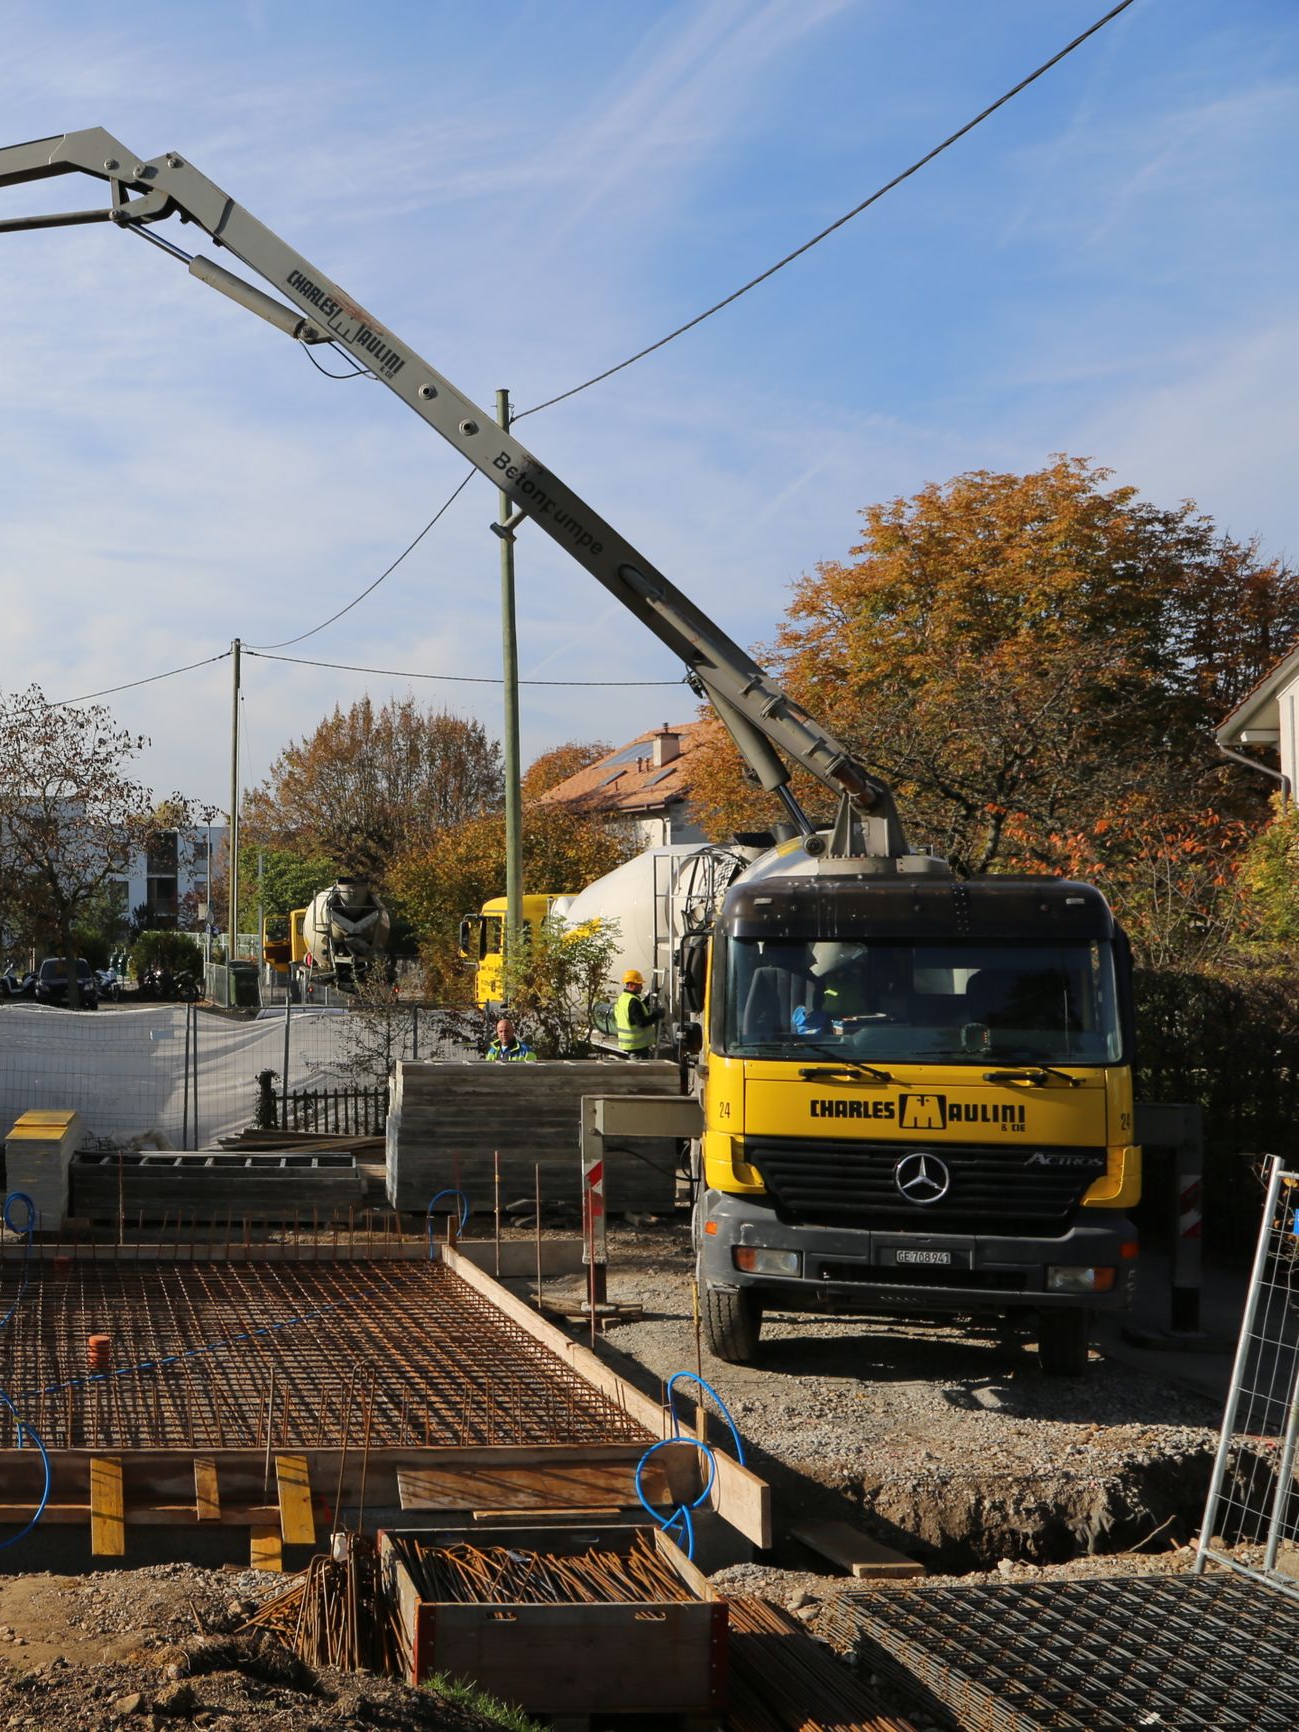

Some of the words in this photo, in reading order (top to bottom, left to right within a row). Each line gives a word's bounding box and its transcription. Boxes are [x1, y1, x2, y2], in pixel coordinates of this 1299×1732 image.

[286, 269, 339, 317] CHARLES
[492, 451, 604, 556] Betonpumpe
[719, 1101, 731, 1119] 24
[810, 1099, 896, 1120] CHARLES
